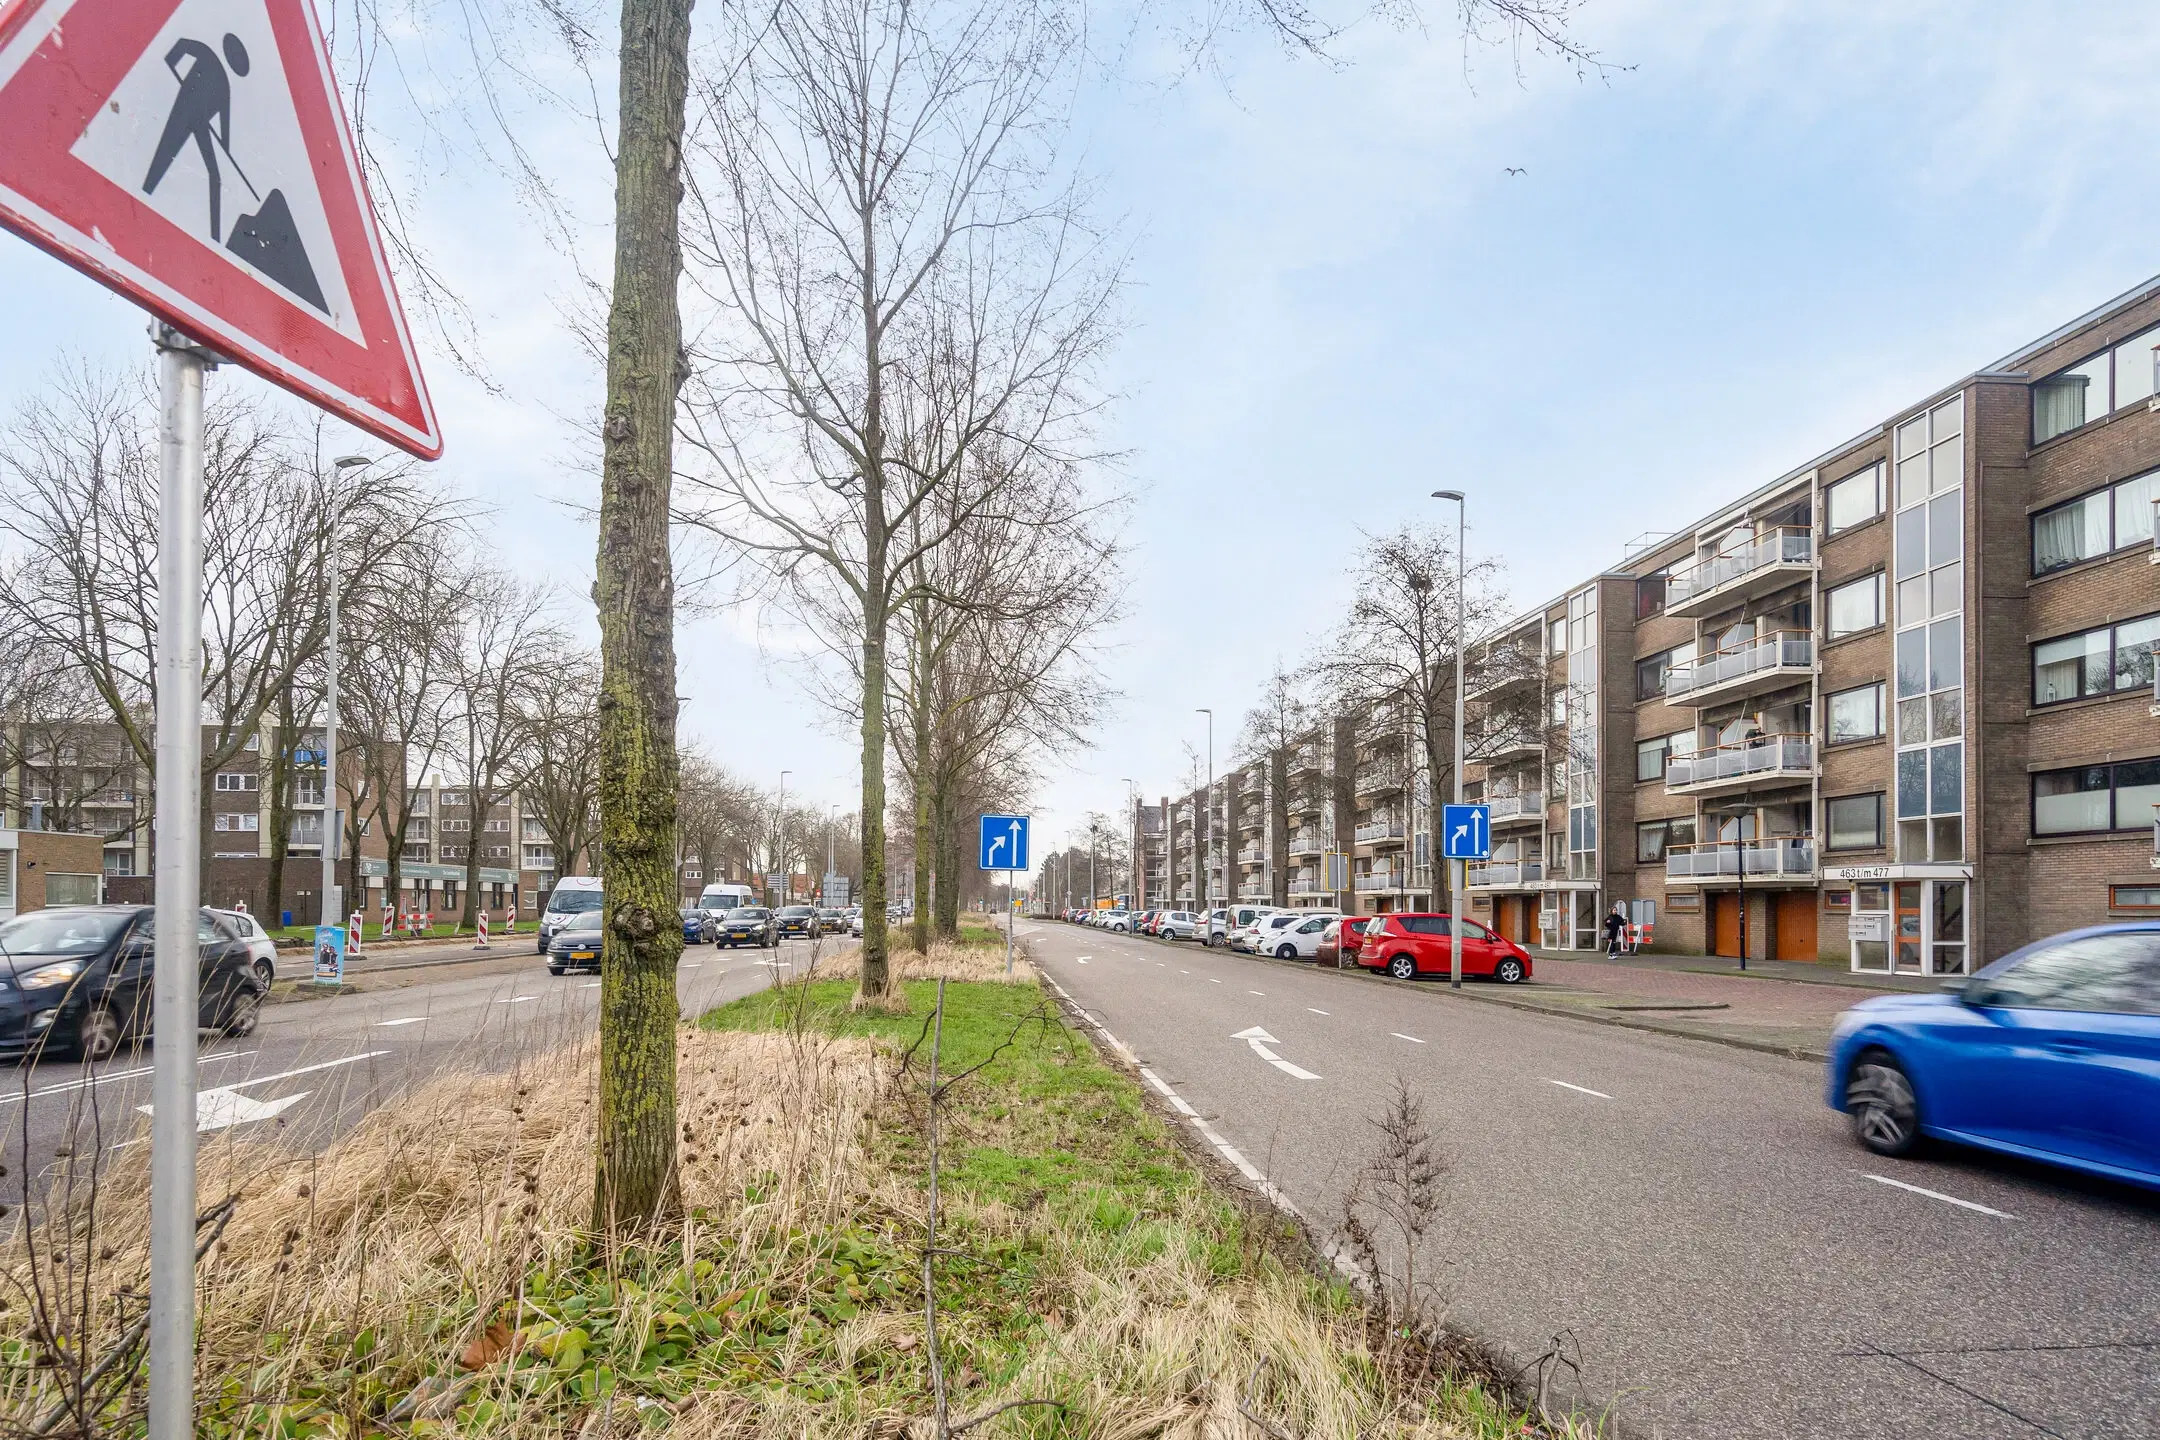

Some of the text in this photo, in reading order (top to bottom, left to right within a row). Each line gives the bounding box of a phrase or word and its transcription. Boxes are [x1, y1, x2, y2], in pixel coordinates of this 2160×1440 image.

[1840, 867, 1889, 878] 463 t/m 477
